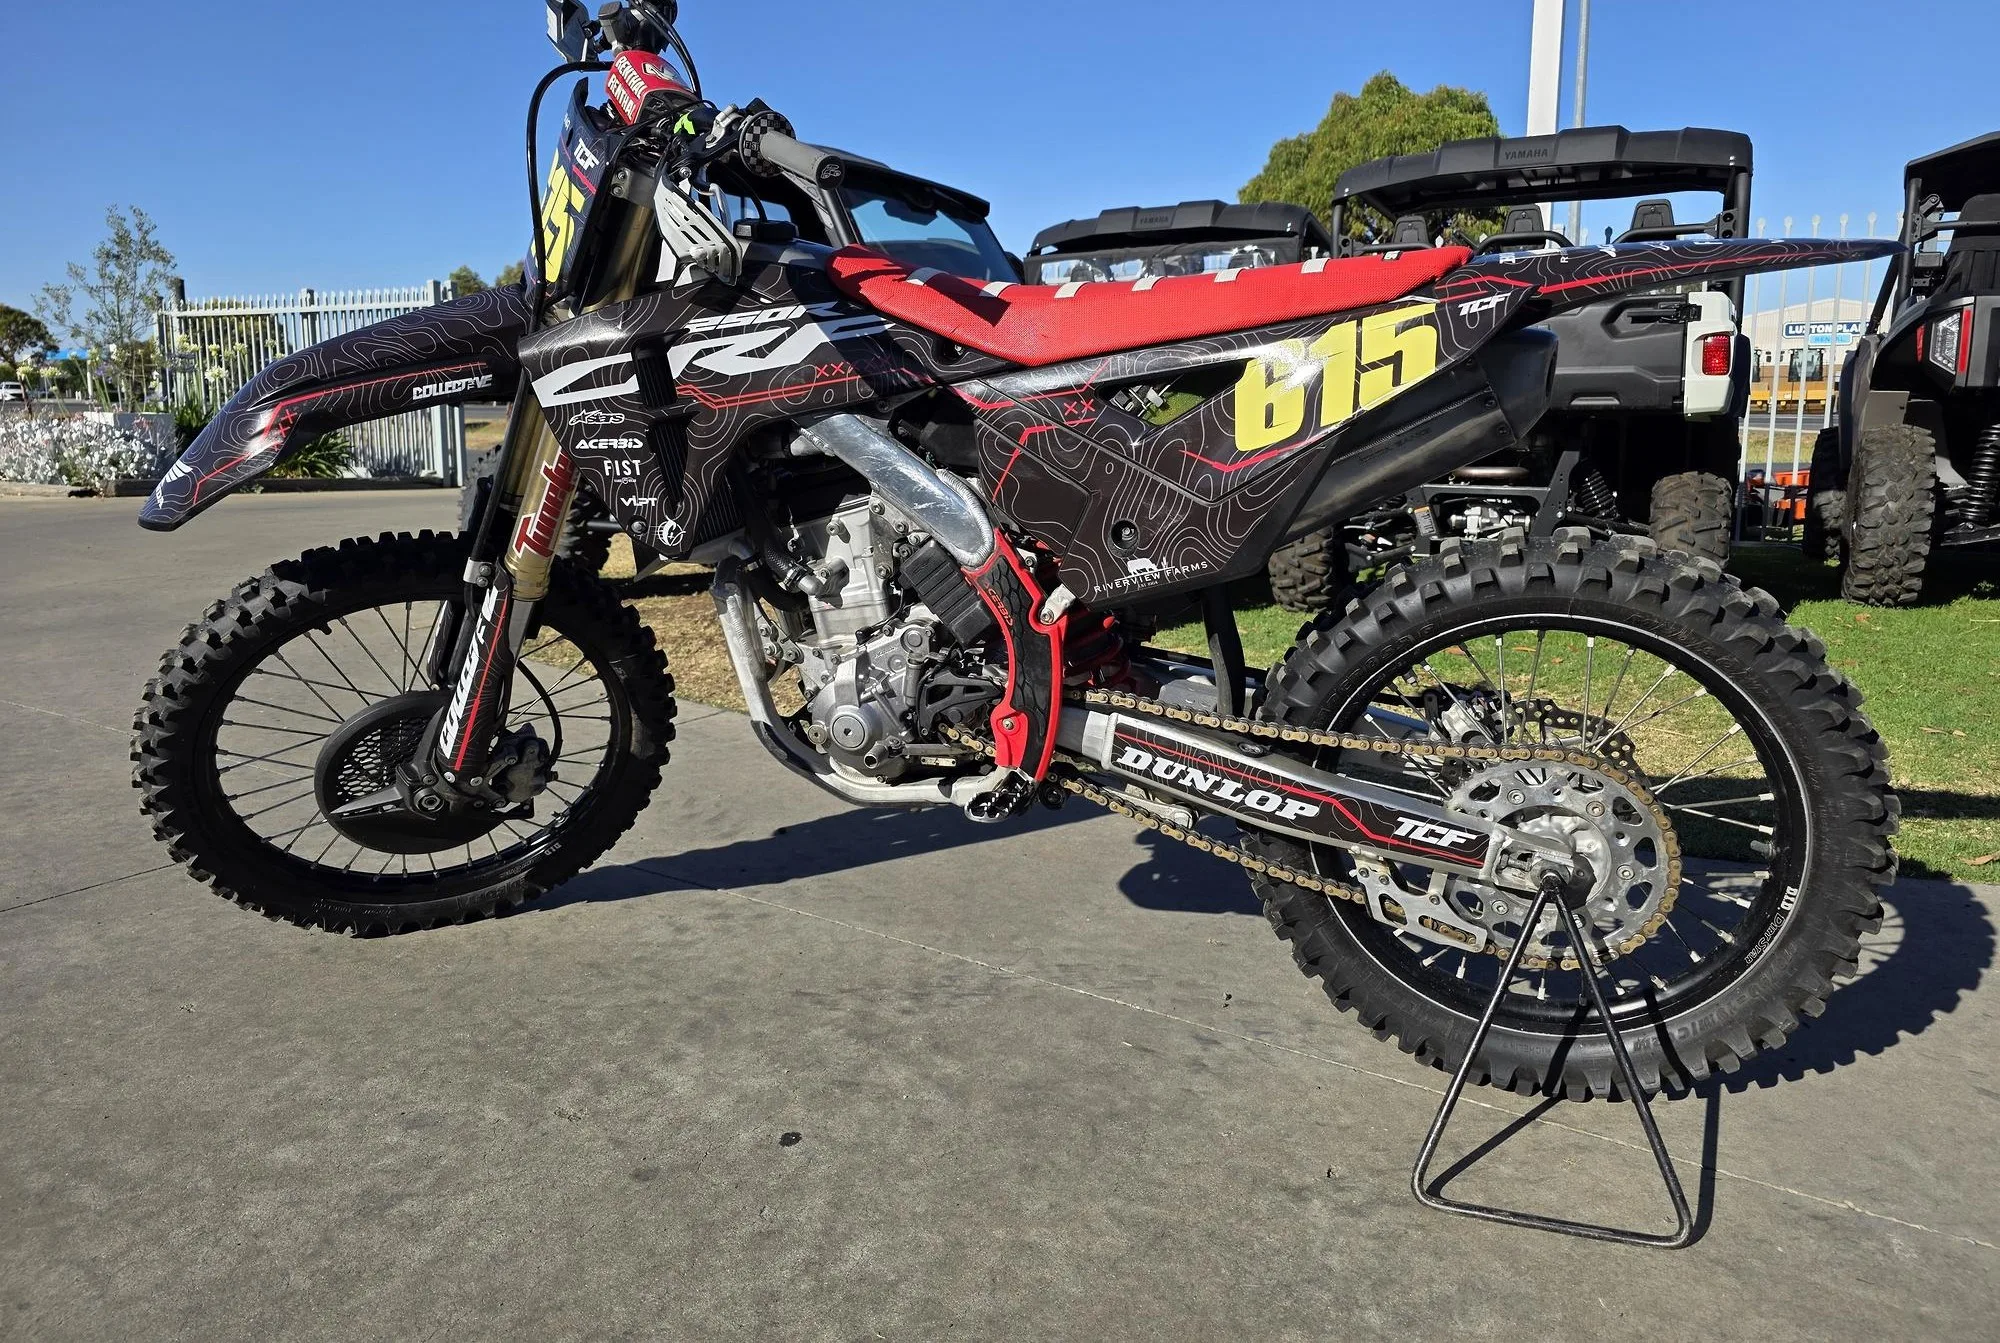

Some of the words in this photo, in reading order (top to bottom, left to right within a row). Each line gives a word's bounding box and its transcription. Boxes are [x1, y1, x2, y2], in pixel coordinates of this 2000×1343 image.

[615, 56, 647, 100] RENTHAL
[607, 73, 636, 121] RENTHAL
[574, 137, 600, 171] TCF
[1505, 147, 1549, 160] YAMAHA
[531, 147, 586, 283] 15
[685, 301, 846, 333] 250R
[1458, 292, 1511, 317] TCF
[1235, 303, 1438, 452] 615
[575, 438, 644, 450] ACERBIS
[603, 460, 641, 476] FIST
[1094, 572, 1161, 594] RIVERVIEW
[1166, 561, 1208, 577] FARMS
[1117, 745, 1320, 821] DUNLOP
[1394, 816, 1478, 848] TCF
